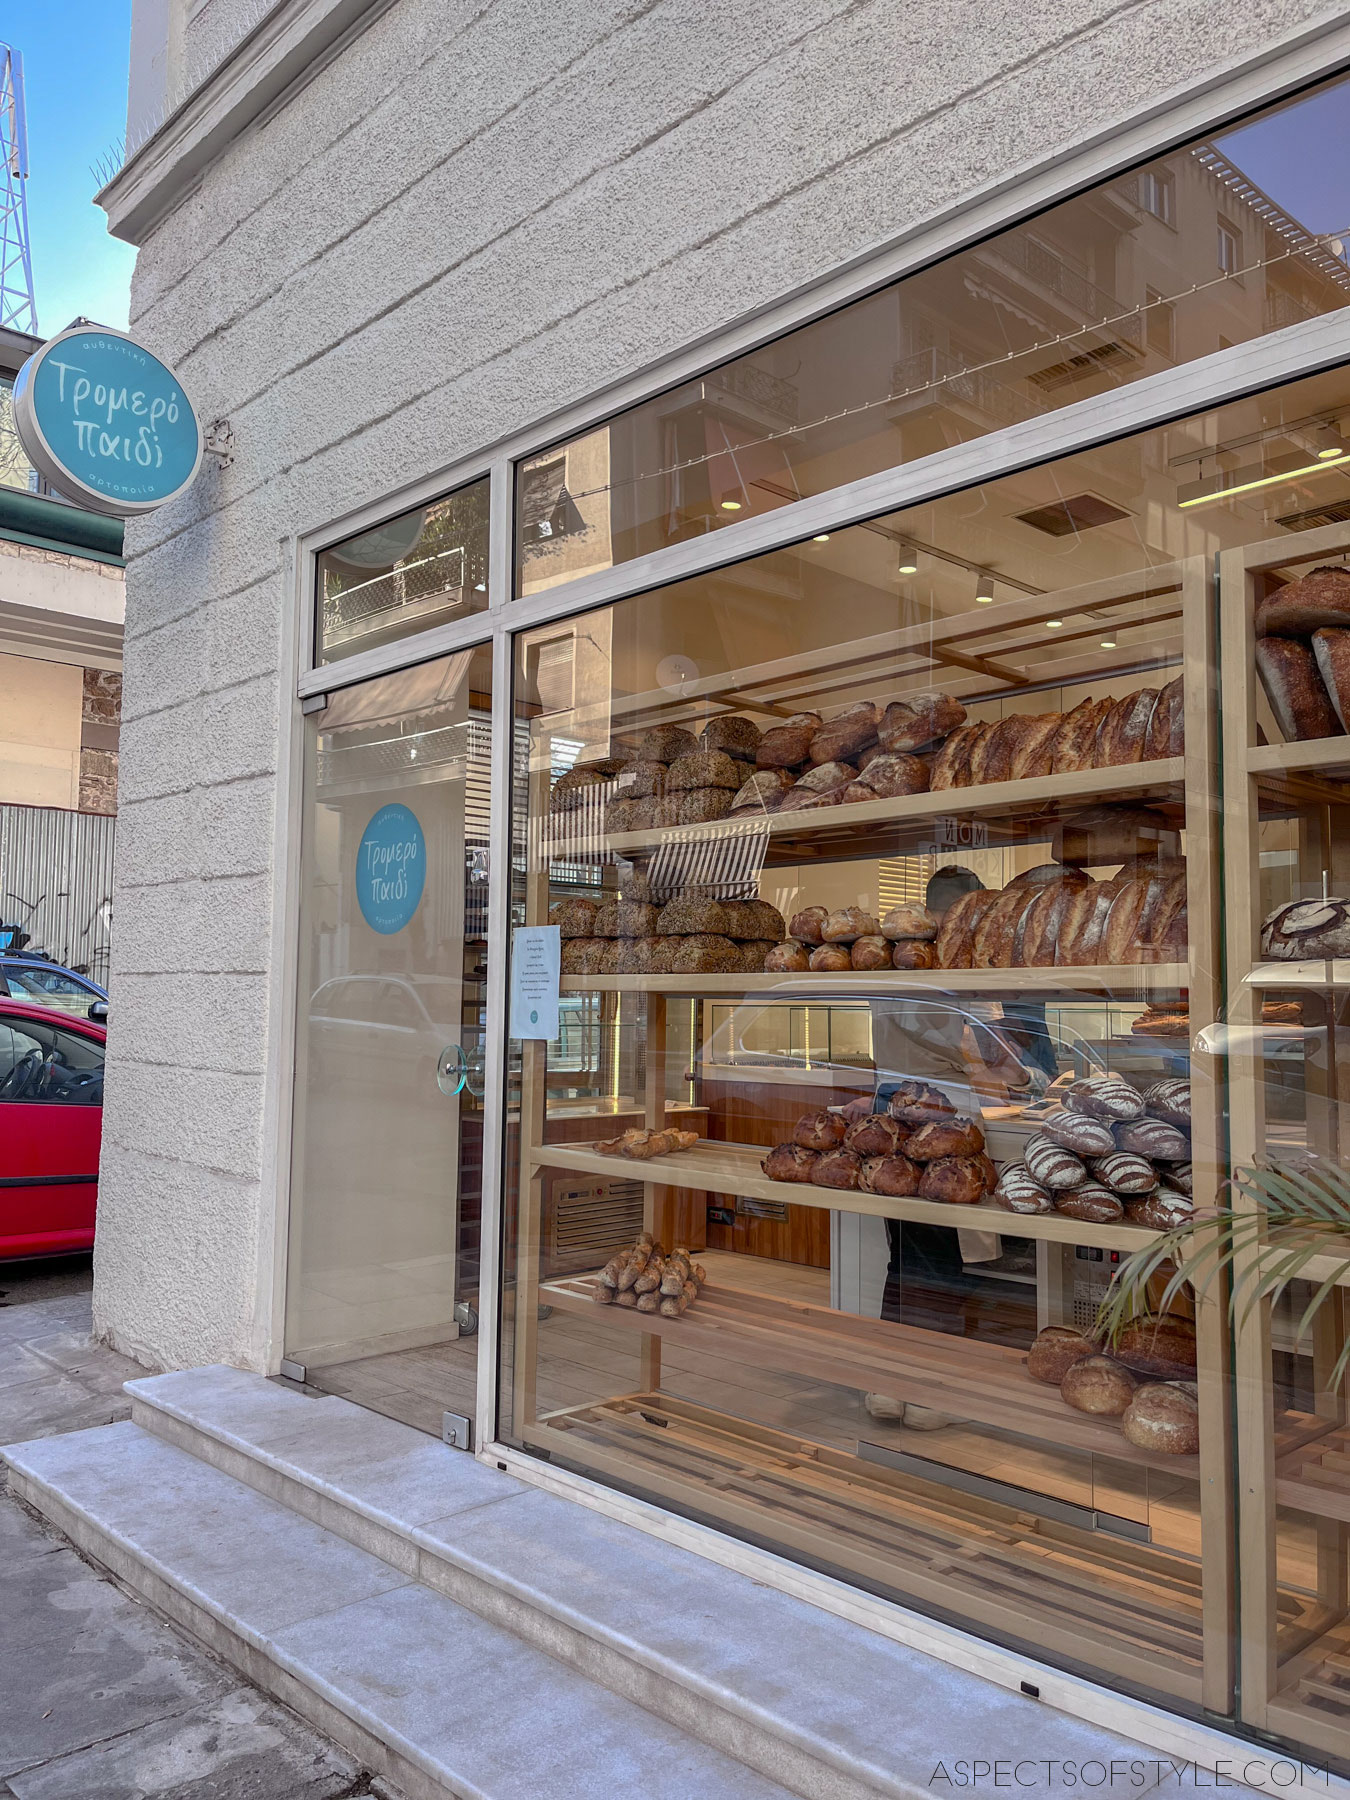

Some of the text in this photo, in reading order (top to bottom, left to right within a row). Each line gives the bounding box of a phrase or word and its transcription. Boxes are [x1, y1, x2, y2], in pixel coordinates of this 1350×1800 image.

[82, 340, 147, 367] αυθεντική
[48, 359, 180, 432] Τρομερό
[88, 473, 156, 494] αρτοποιία
[364, 833, 418, 876] Τρομερό
